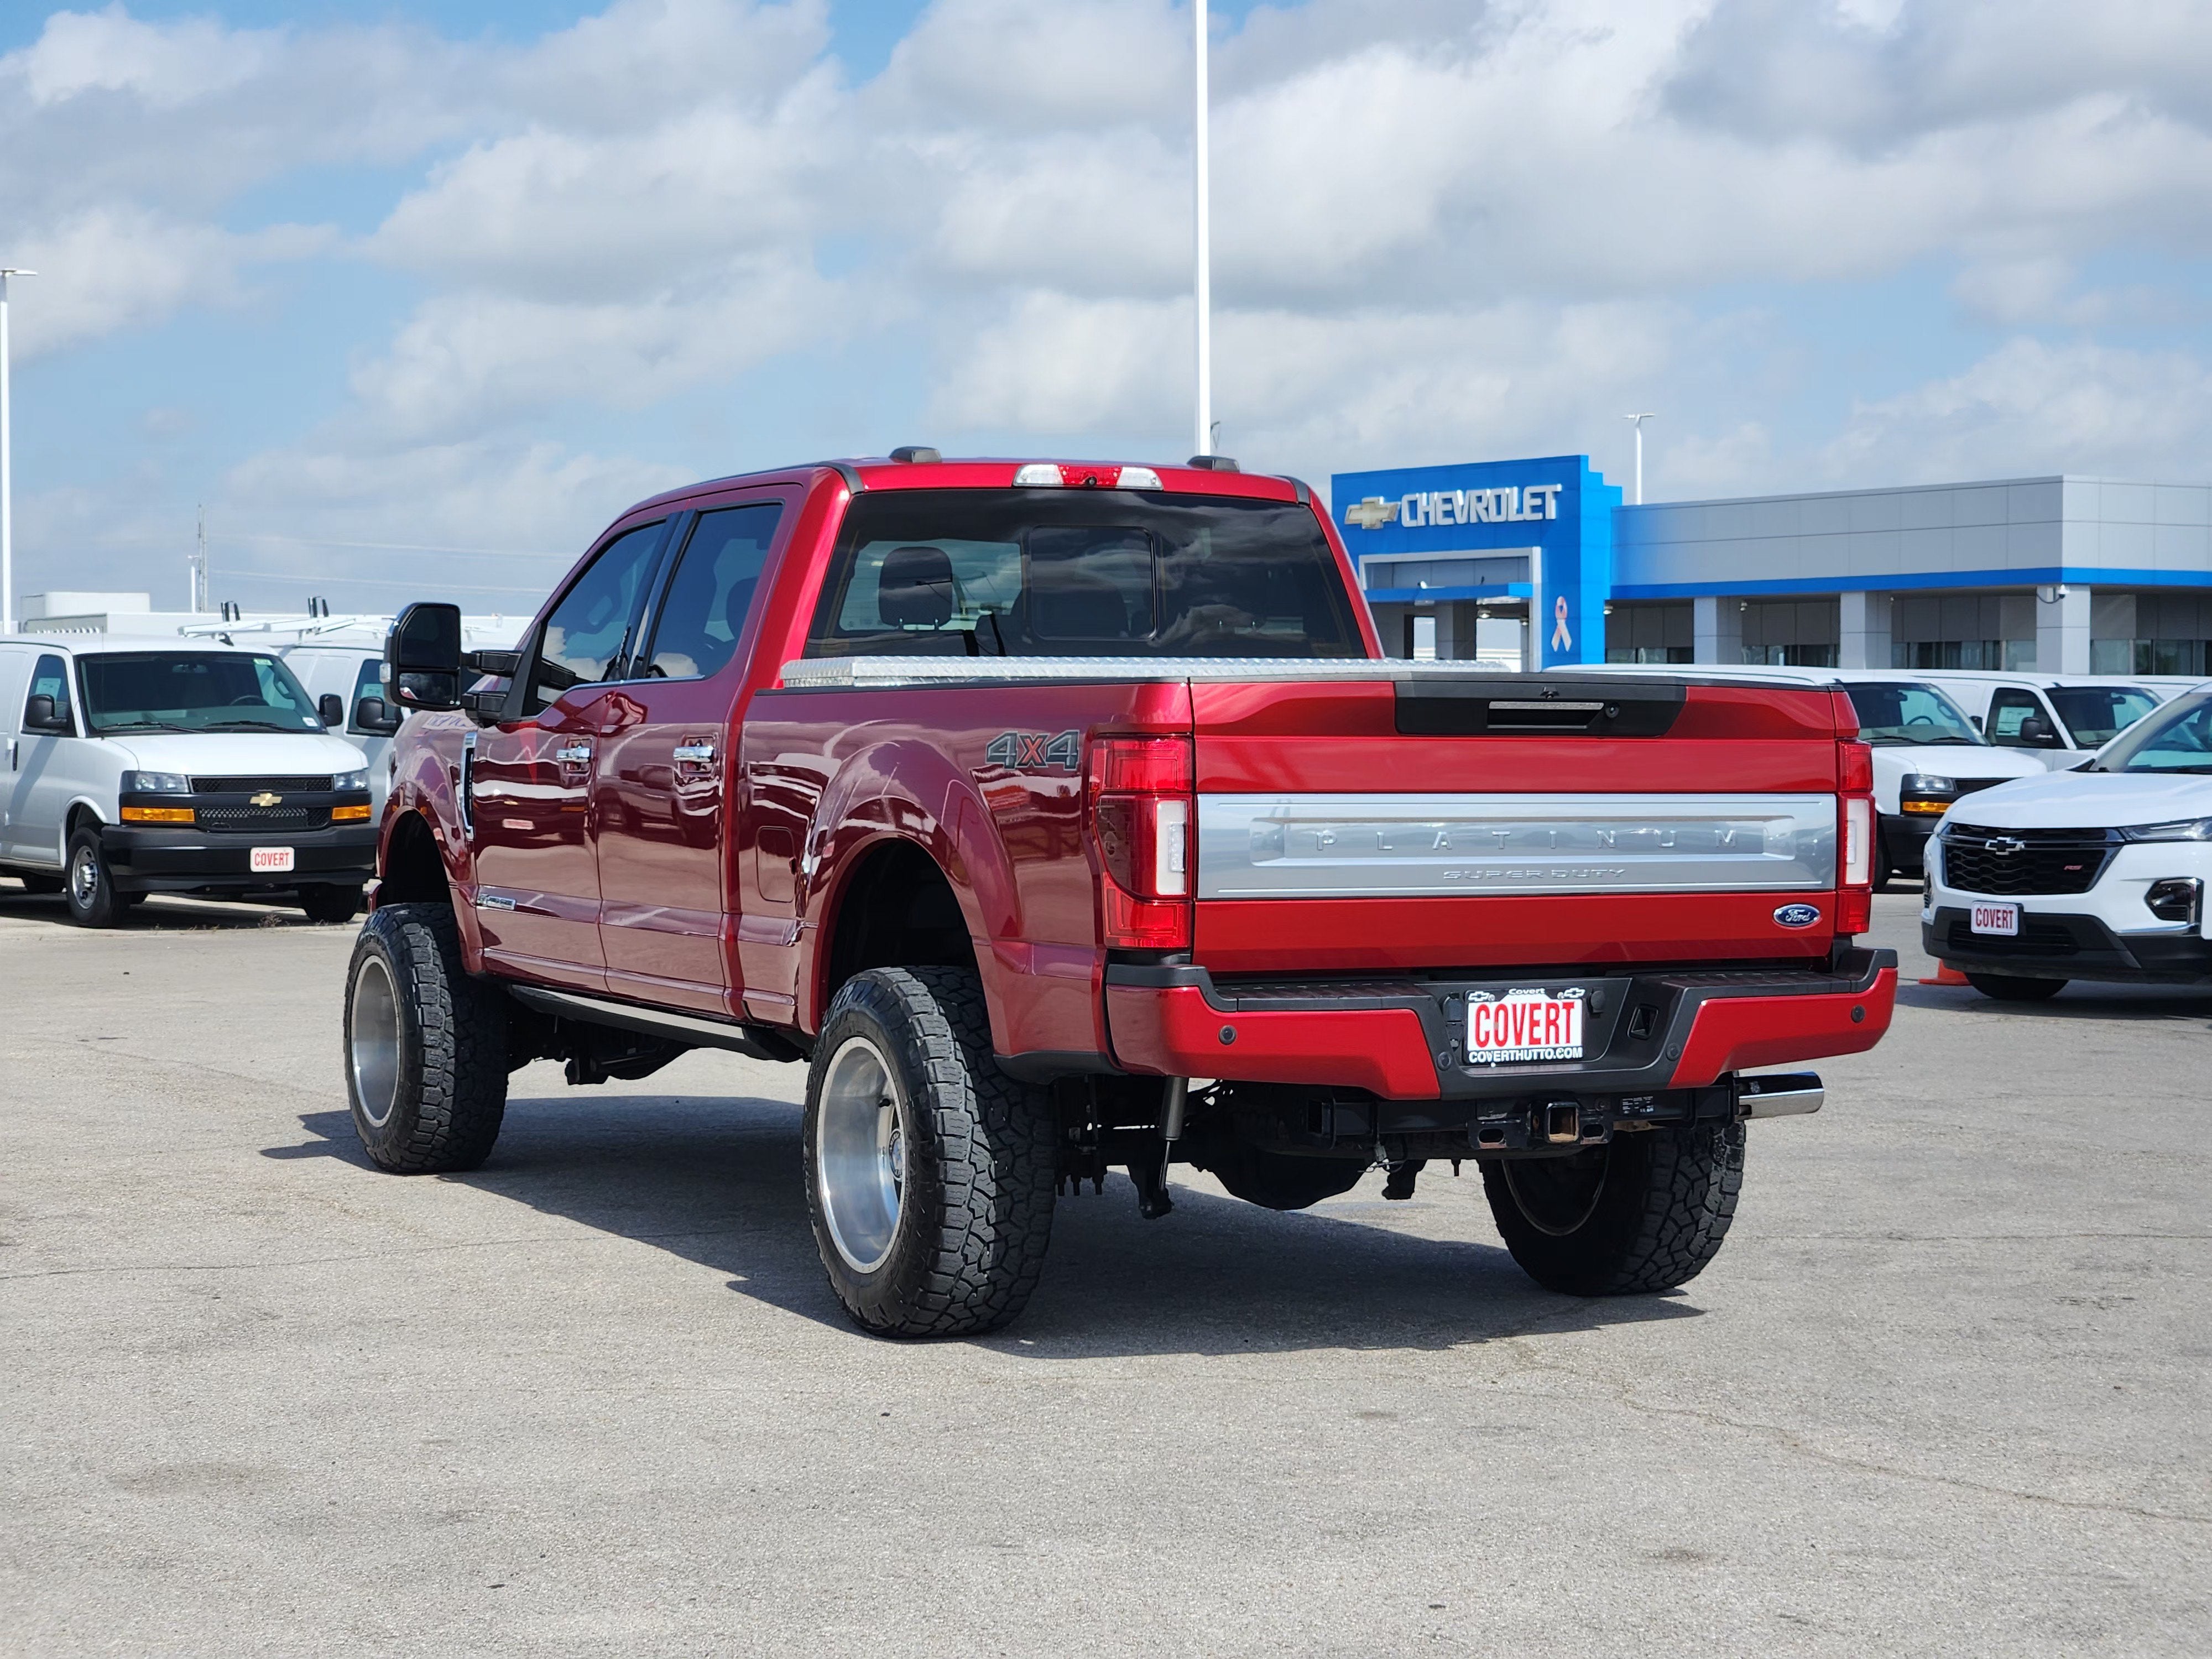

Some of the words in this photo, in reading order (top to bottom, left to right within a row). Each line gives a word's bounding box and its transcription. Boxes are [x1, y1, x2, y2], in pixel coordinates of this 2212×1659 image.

[1401, 484, 1562, 527] CHEVROLET
[1316, 829, 1736, 851] PLATINUM
[255, 852, 290, 866] COVERT
[1443, 870, 1544, 880] SUPER
[1551, 869, 1626, 878] DUTY
[1785, 909, 1811, 922] Ford
[1975, 907, 2013, 930] COVERT
[1475, 1001, 1574, 1047] COVERT
[1469, 1047, 1583, 1063] COVERTHUTTO.COM
